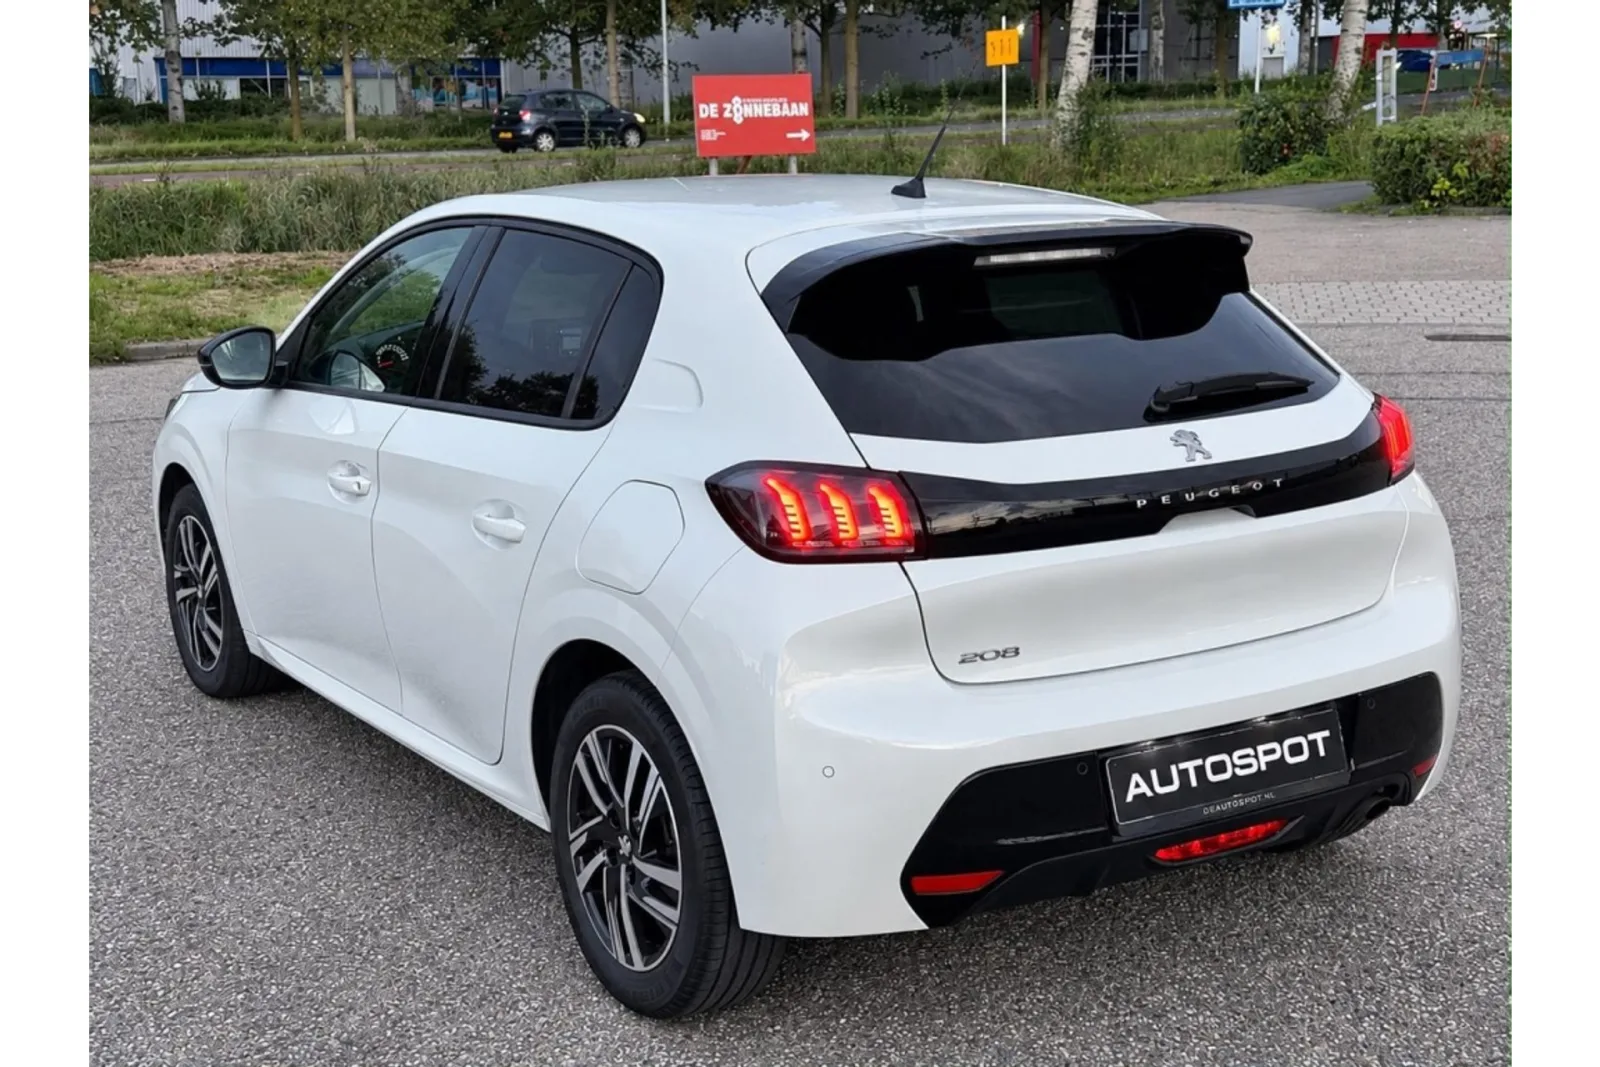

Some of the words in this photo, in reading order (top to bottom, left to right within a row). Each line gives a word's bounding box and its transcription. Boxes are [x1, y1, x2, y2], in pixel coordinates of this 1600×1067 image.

[698, 103, 719, 118] DE
[722, 98, 809, 122] ZONNEBAAN
[1136, 478, 1283, 508] PEUGEOT
[958, 646, 1020, 665] 208
[1125, 729, 1331, 803] AUTOSPOT
